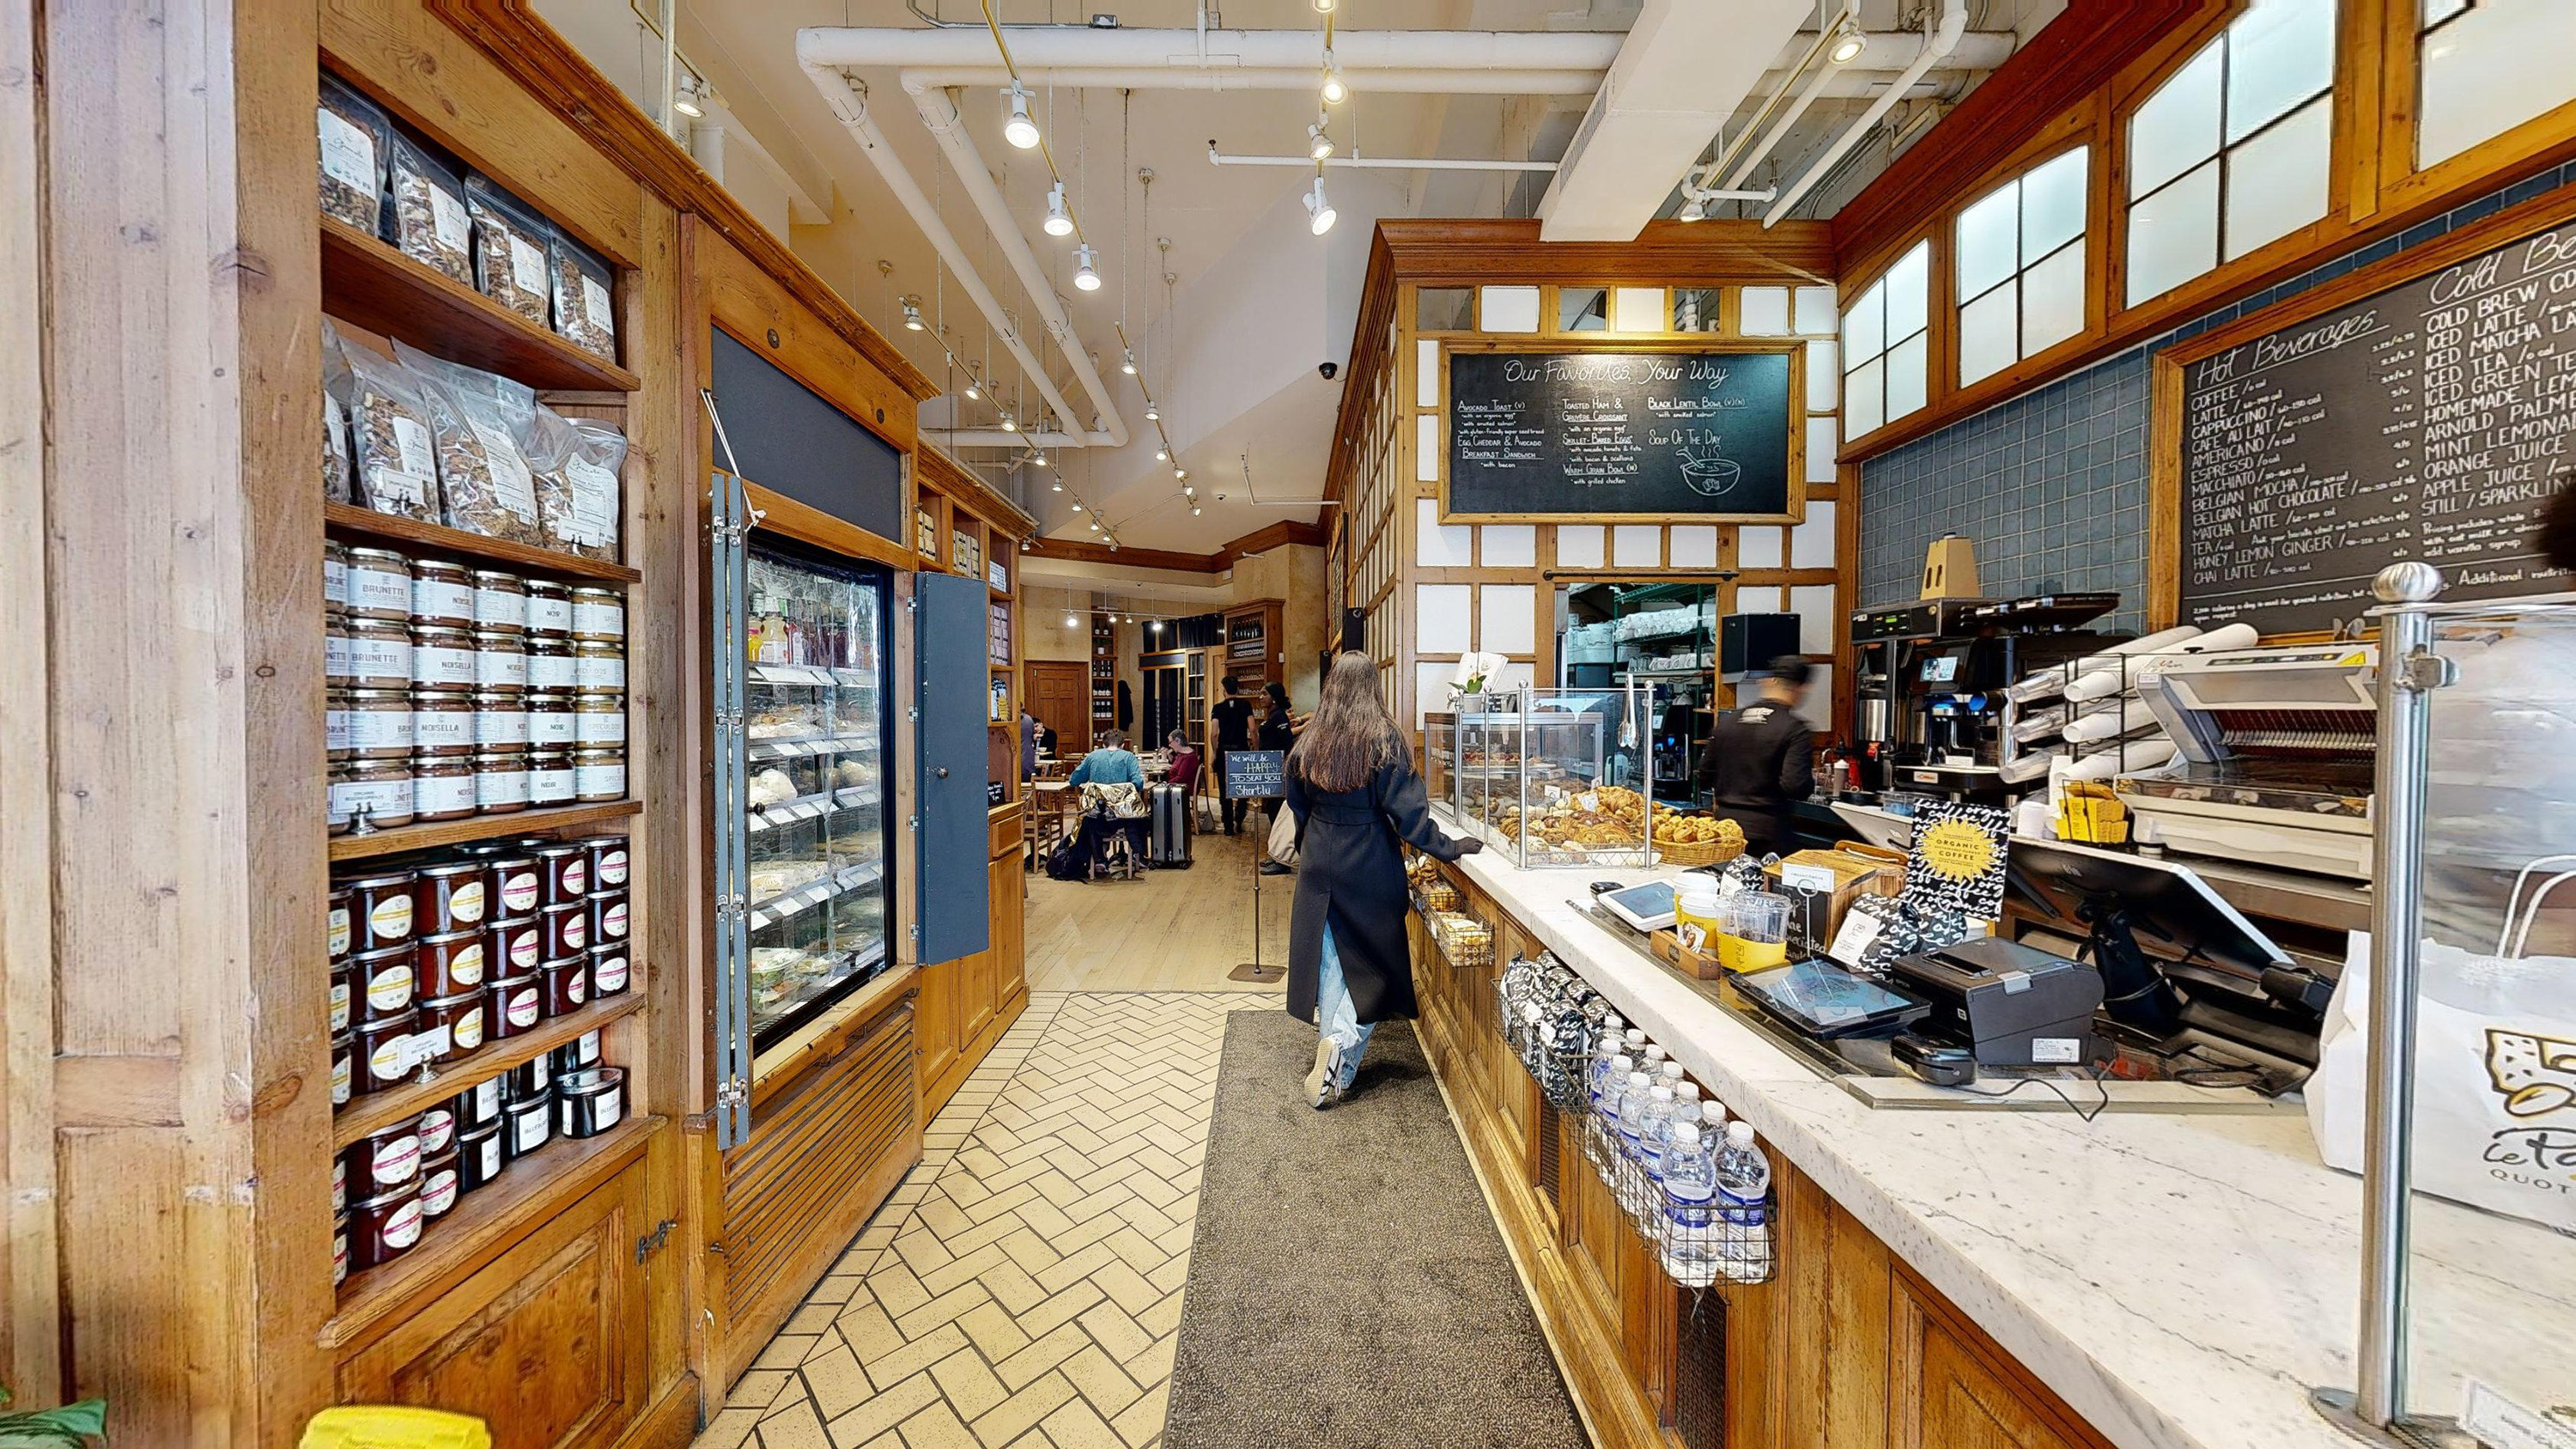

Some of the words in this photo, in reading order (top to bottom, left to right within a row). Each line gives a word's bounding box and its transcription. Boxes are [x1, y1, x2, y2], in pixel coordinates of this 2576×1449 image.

[2430, 251, 2504, 304] Cold
[2427, 307, 2469, 333] COLD
[2477, 281, 2539, 318] BREW
[2426, 327, 2462, 351] ICED
[2474, 305, 2527, 338] LATTE
[2197, 347, 2246, 388] Hot
[2252, 310, 2378, 369] Beverages
[2425, 347, 2461, 370] ICED
[2469, 322, 2541, 357] MATCHA
[1504, 360, 1540, 381] Our
[1637, 359, 1683, 384] Your
[1689, 360, 1729, 389] Way
[2424, 366, 2463, 389] ICED
[2470, 352, 2509, 375] TEA
[2424, 383, 2463, 407] ICED
[2471, 361, 2540, 393] GREEN
[1614, 398, 1623, 409] &
[2191, 384, 2239, 411] COFFEE
[2424, 386, 2524, 424] HOMEMADE
[2192, 404, 2227, 425] LATTE
[2192, 407, 2267, 439] CAPPUCCINO
[2424, 412, 2494, 443] ARNOLD
[1504, 435, 1512, 446] &
[2227, 428, 2242, 444] AU
[2247, 419, 2274, 439] LAIT
[2192, 438, 2264, 469] AMERICANO
[2424, 450, 2494, 479] ORANGE
[2508, 435, 2568, 463] JUICE
[2425, 435, 2473, 461] MINT
[2191, 457, 2254, 484] ESPRESSO
[2192, 470, 2256, 497] MACCHIATO
[2423, 475, 2473, 498] APPLE
[2483, 462, 2536, 488] JUICE
[2192, 490, 2245, 513] BELGIAN
[2254, 478, 2298, 499] MOCHA
[2193, 504, 2242, 527] BELGIAN
[2249, 497, 2271, 514] HOT
[2278, 482, 2346, 508] CHOCOLATE
[2421, 496, 2460, 516] STILL
[2192, 523, 2234, 541] MATCHA
[2240, 514, 2278, 533] LATTE
[2191, 542, 2213, 556] TEA
[2193, 553, 2229, 570] HONEY
[2235, 544, 2274, 563] LEMON
[2282, 535, 2333, 557] GINGER
[2193, 570, 2217, 585] CHAI
[2225, 563, 2258, 581] LATTE
[362, 584, 405, 596] BRUNETTE
[352, 653, 398, 663] BRUNETTE
[1236, 784, 1271, 795] Shortly
[1936, 839, 1979, 850] ORGANIC
[1939, 850, 1974, 861] COFFEE
[2490, 1169, 2572, 1195] QUOT
